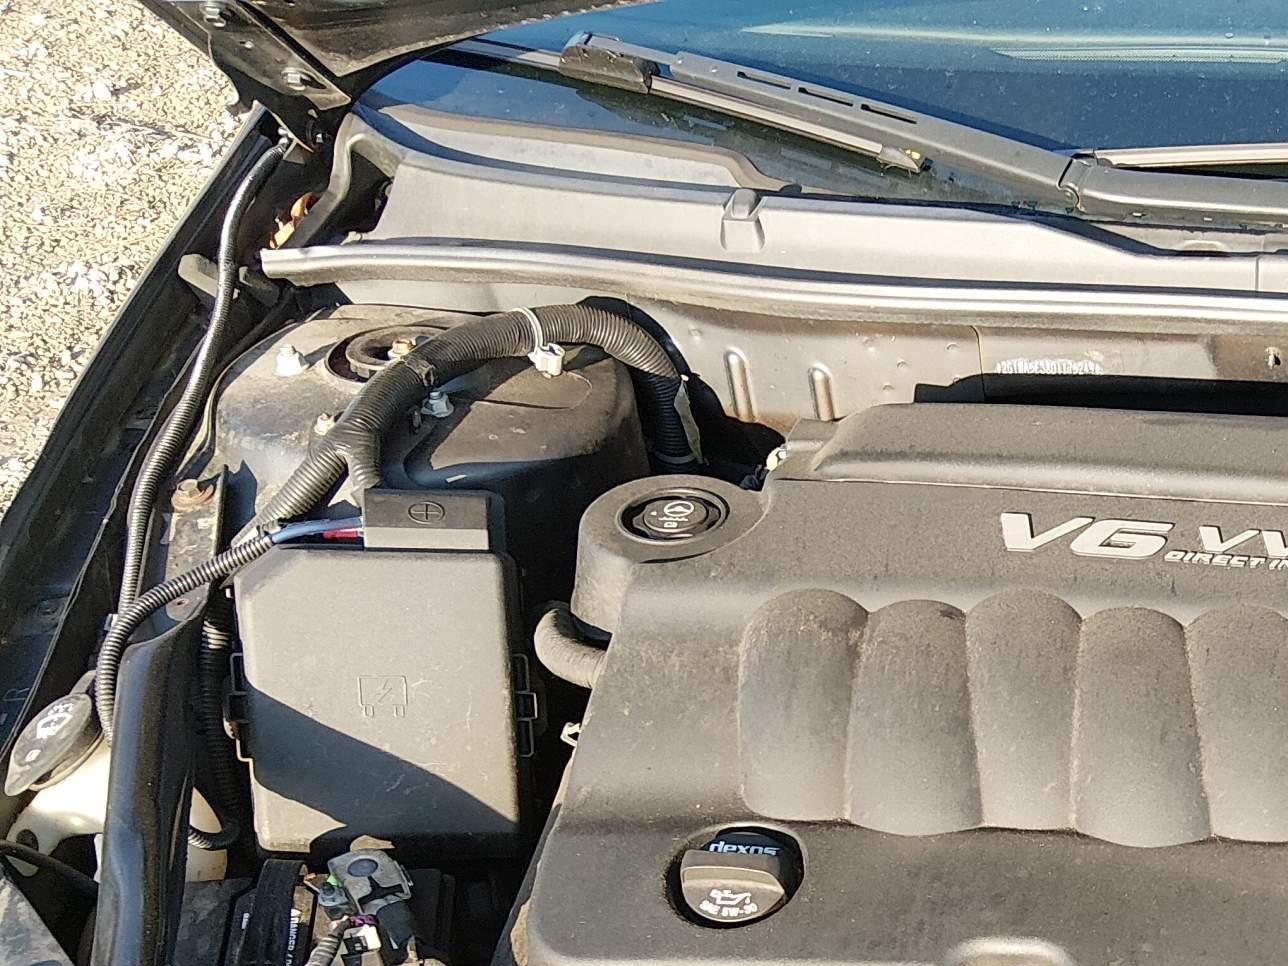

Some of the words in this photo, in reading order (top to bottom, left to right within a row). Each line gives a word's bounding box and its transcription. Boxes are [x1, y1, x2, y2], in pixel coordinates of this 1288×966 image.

[1000, 512, 1175, 560] V6
[1164, 549, 1266, 568] DIRECT
[709, 841, 780, 857] dexos
